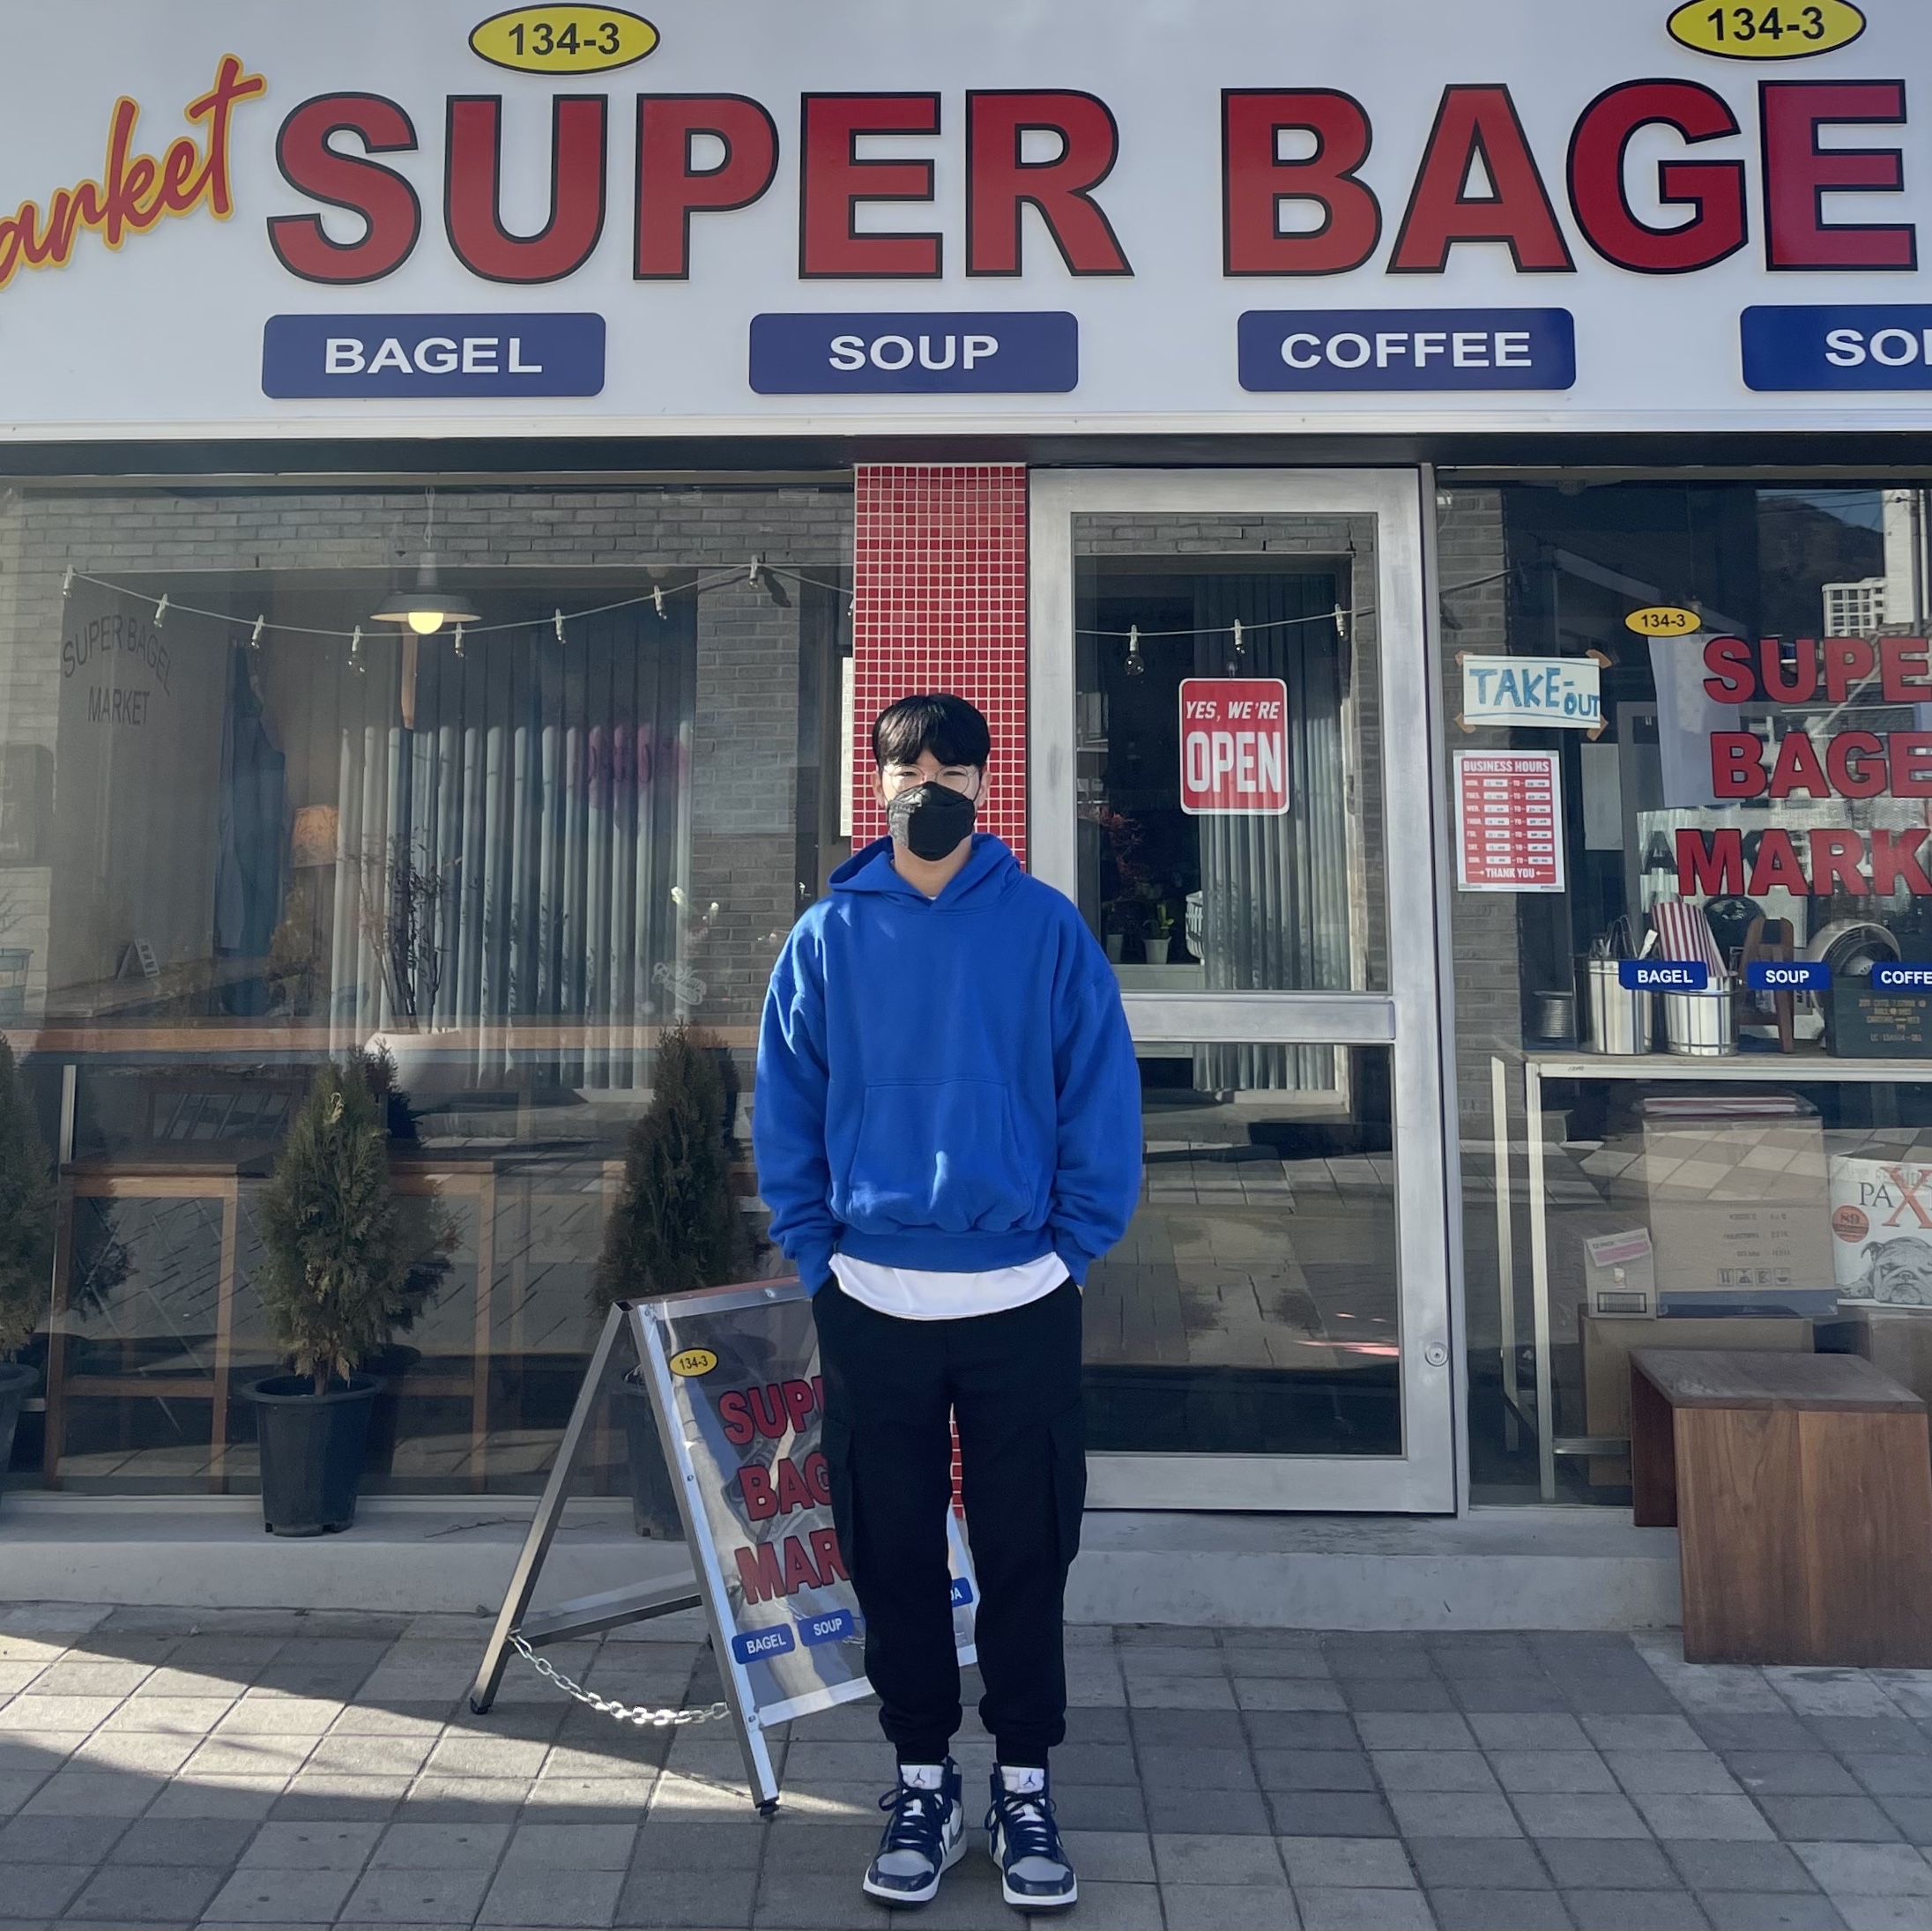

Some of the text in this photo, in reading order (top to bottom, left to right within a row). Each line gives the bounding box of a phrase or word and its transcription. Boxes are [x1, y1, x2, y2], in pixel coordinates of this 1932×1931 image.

[508, 22, 620, 56] 134-3
[1707, 6, 1824, 41] 134-3
[266, 77, 1919, 286] SUPER BAGE
[324, 337, 543, 375] BAGEL
[829, 334, 999, 371] SOUP
[1281, 330, 1532, 369] COFFEE
[1640, 613, 1686, 628] 134-3
[63, 615, 172, 698] SUPER BAGEL
[1703, 635, 1932, 704] SUPE
[87, 686, 151, 725] MARKET
[1185, 701, 1281, 723] YES, WE'RE
[1186, 731, 1282, 793] OPEN
[1463, 761, 1549, 773] BUSINESS HOURS
[1710, 731, 1932, 799] BAGE
[1485, 867, 1535, 880] THANK YOU
[1675, 828, 1932, 897] MARK
[1637, 969, 1694, 984] BAGEL
[1765, 969, 1810, 984] SOUP
[1880, 970, 1932, 984] COFFE
[679, 1355, 709, 1370] 134-3
[718, 1375, 825, 1445] SUP
[734, 1527, 851, 1605] MAR
[746, 1633, 787, 1654] BAGEL
[814, 1617, 843, 1637] SOUP
